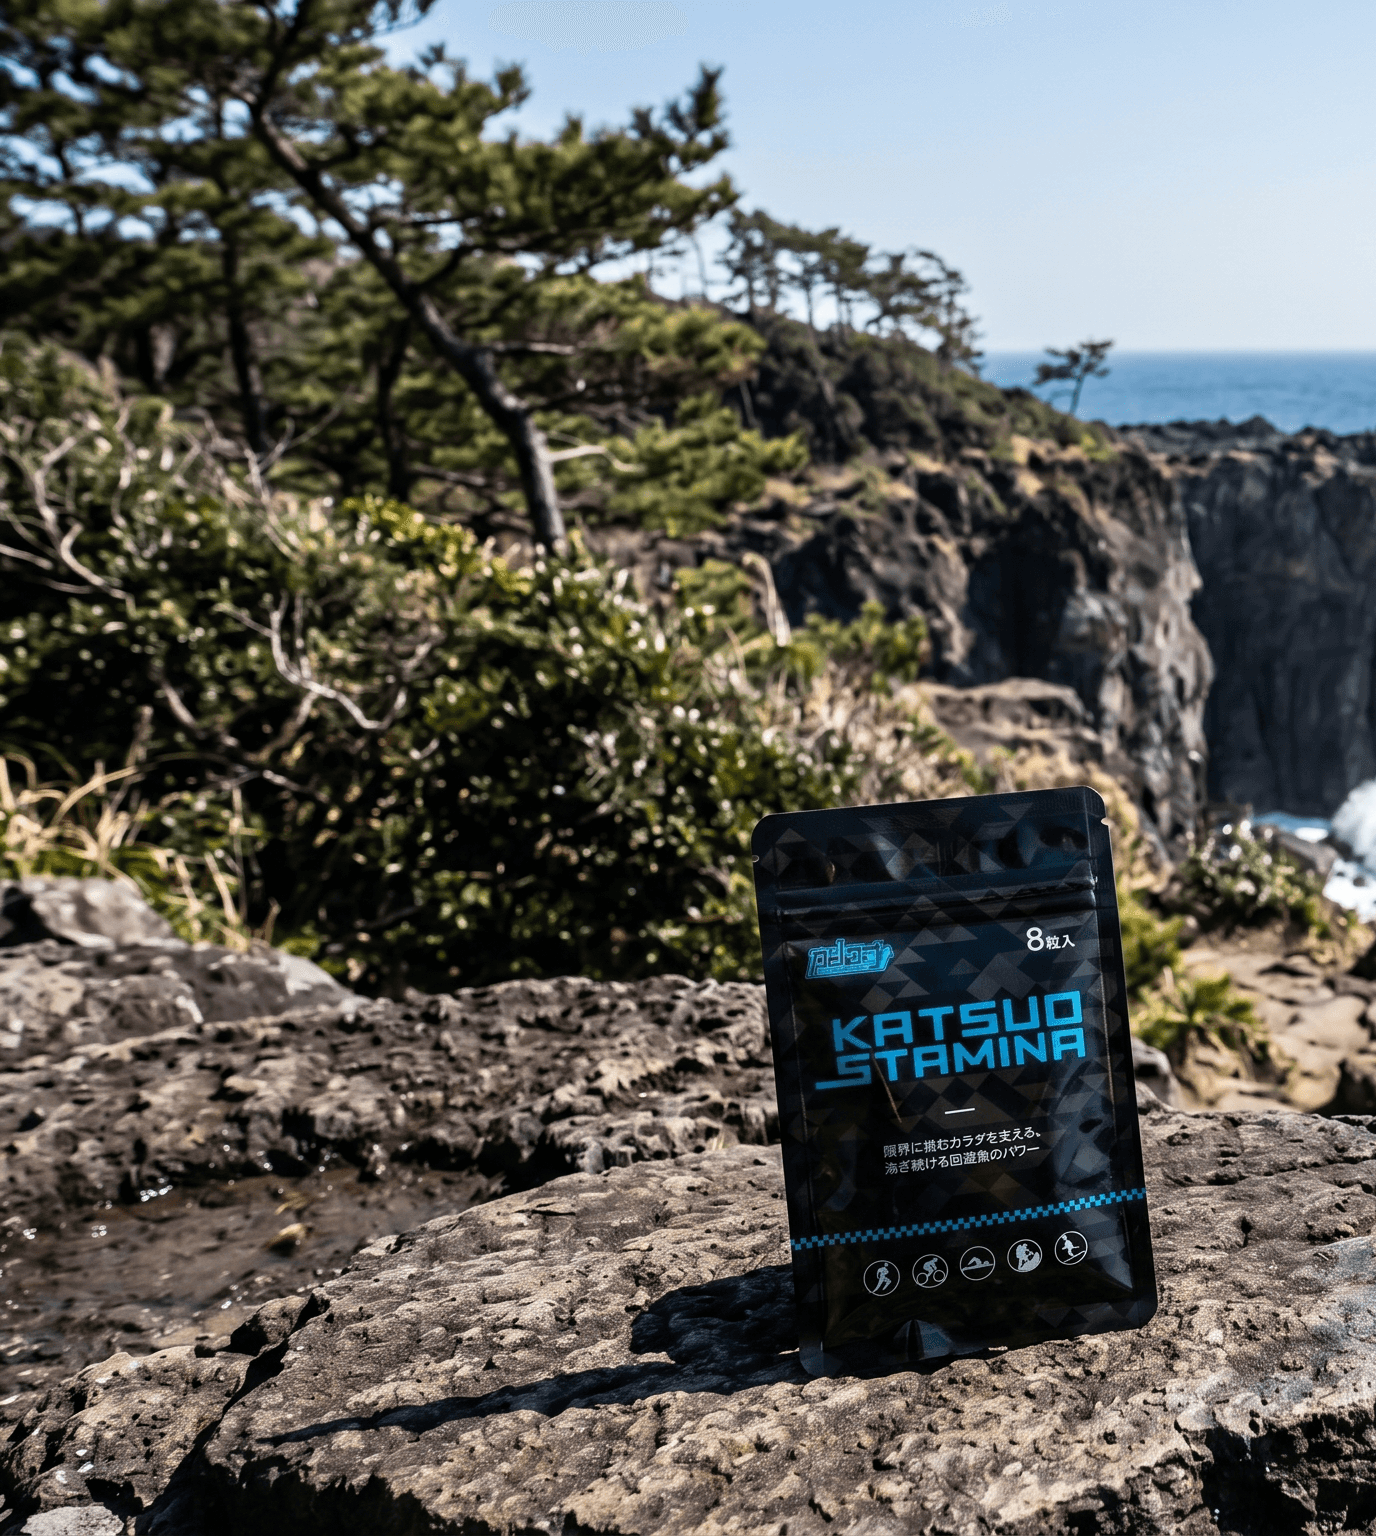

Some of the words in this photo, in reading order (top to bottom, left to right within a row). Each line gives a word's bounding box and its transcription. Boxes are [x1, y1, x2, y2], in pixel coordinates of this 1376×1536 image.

[1026, 926, 1076, 952] 8粒入
[832, 990, 1083, 1051] KATSUO
[815, 1027, 1086, 1090] STAMINA
